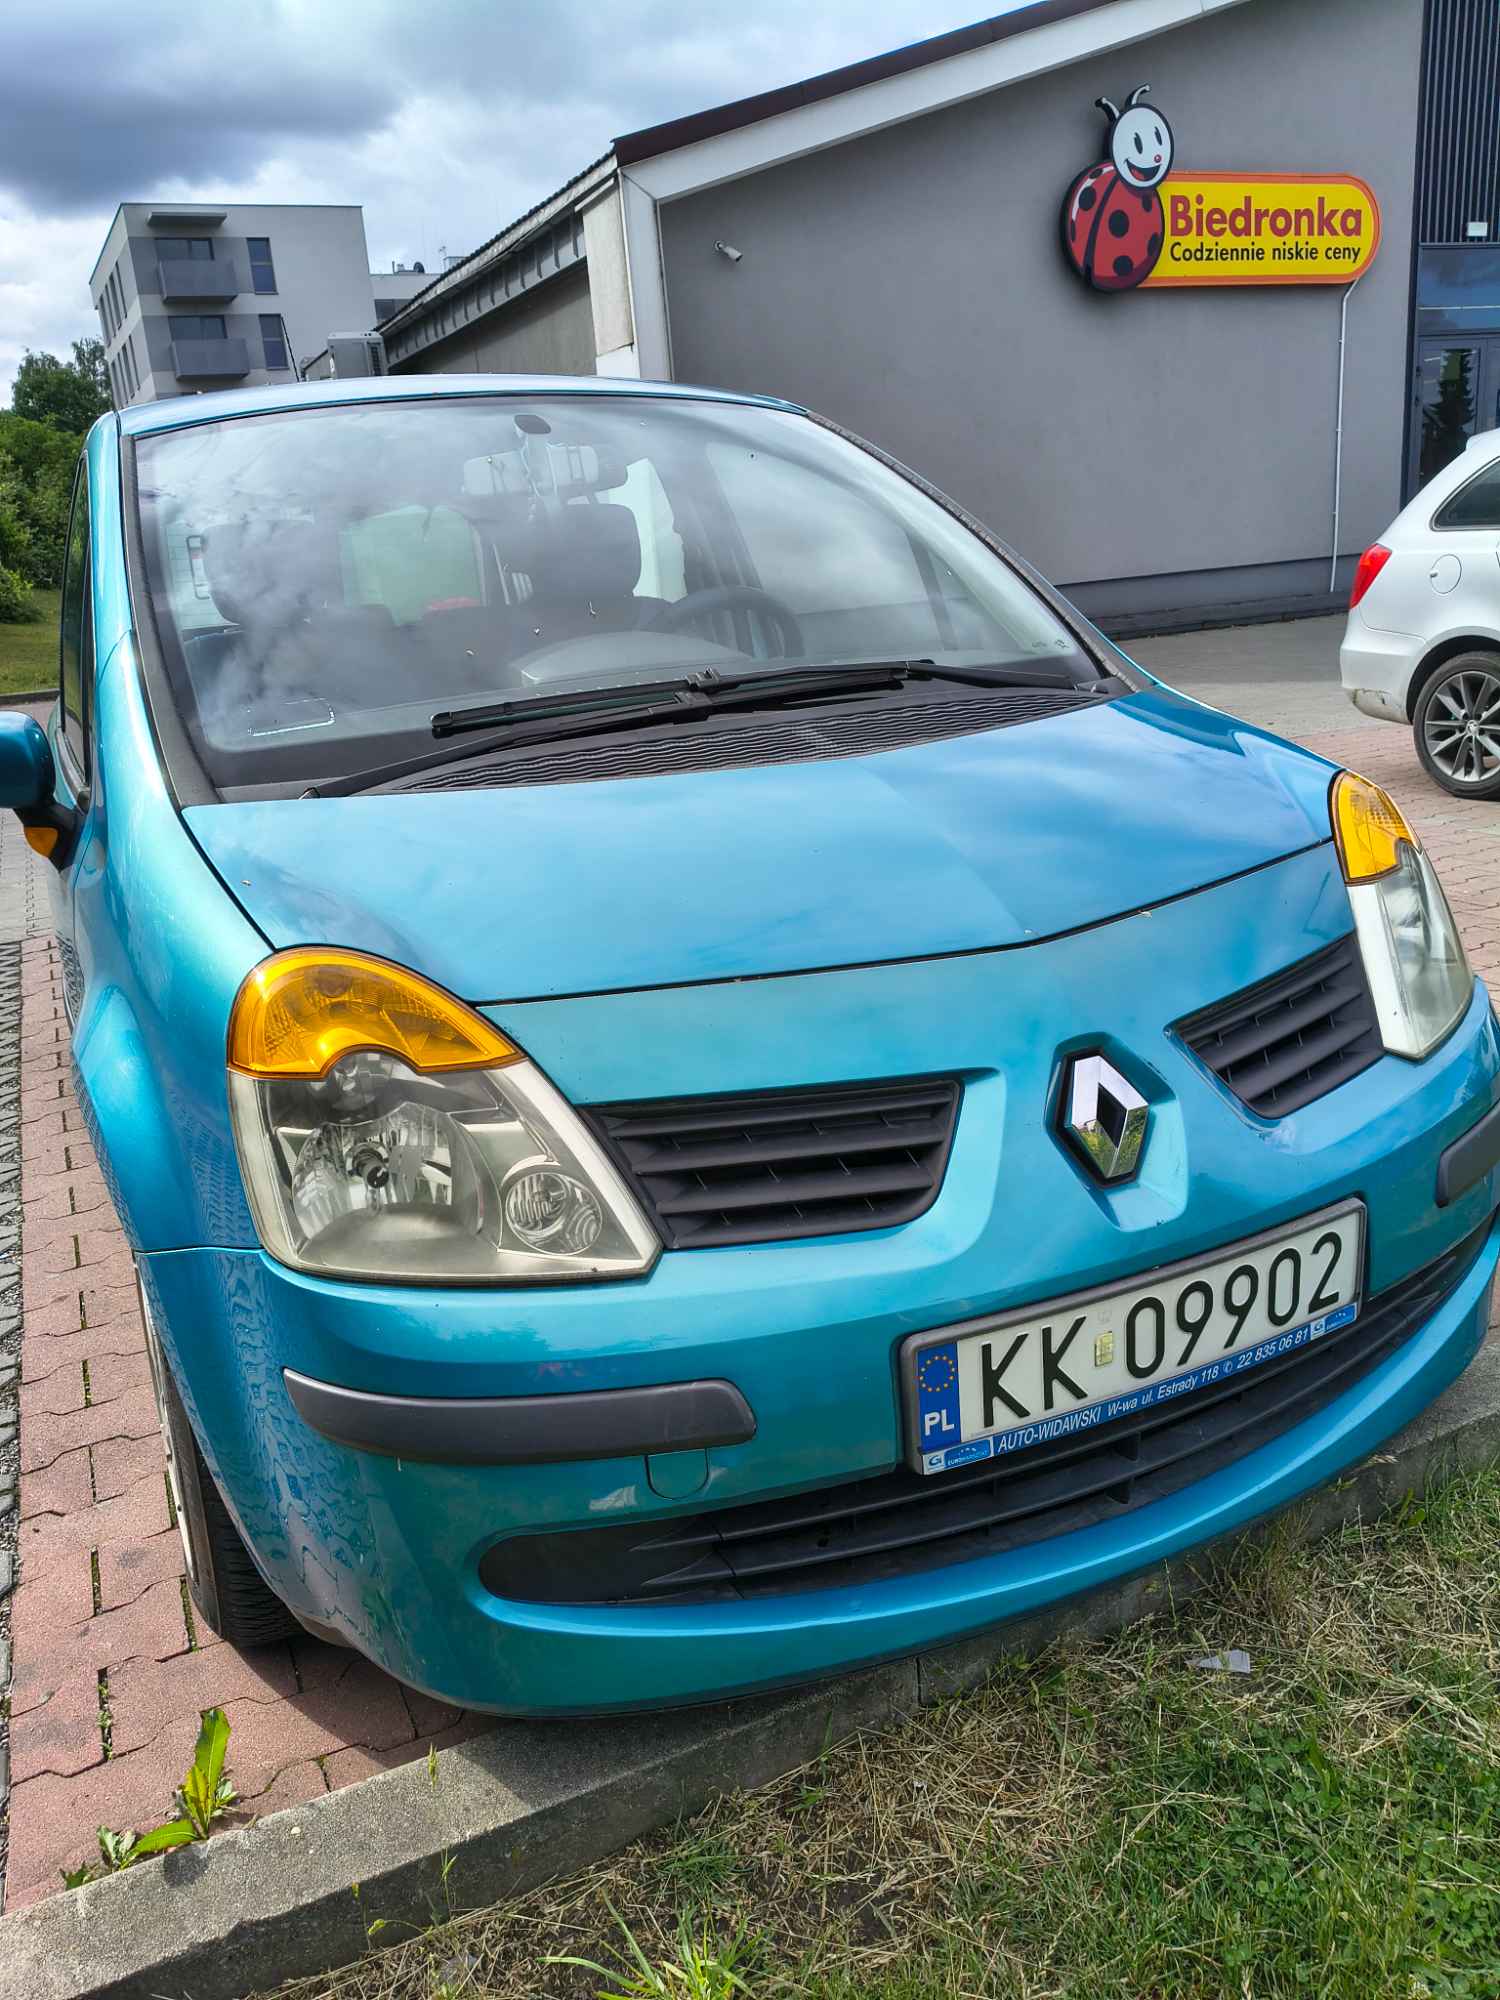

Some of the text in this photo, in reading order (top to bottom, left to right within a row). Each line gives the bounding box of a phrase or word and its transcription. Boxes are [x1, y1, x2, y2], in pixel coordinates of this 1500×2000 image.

[1170, 194, 1362, 237] Biedronka
[1170, 242, 1361, 263] Codziennie niskie ceny
[981, 1231, 1343, 1428] KK 09902
[998, 1406, 1102, 1453] AUTO-WIDAWSKI
[1107, 1398, 1137, 1416] W-wa
[1141, 1391, 1154, 1405] ul.
[1157, 1375, 1198, 1400] Estrady
[1201, 1366, 1219, 1382] 118
[1237, 1352, 1253, 1369] 22
[1255, 1343, 1277, 1360] 835
[1278, 1334, 1293, 1351] 06
[1295, 1327, 1308, 1344] 81
[924, 1409, 955, 1436] PL
